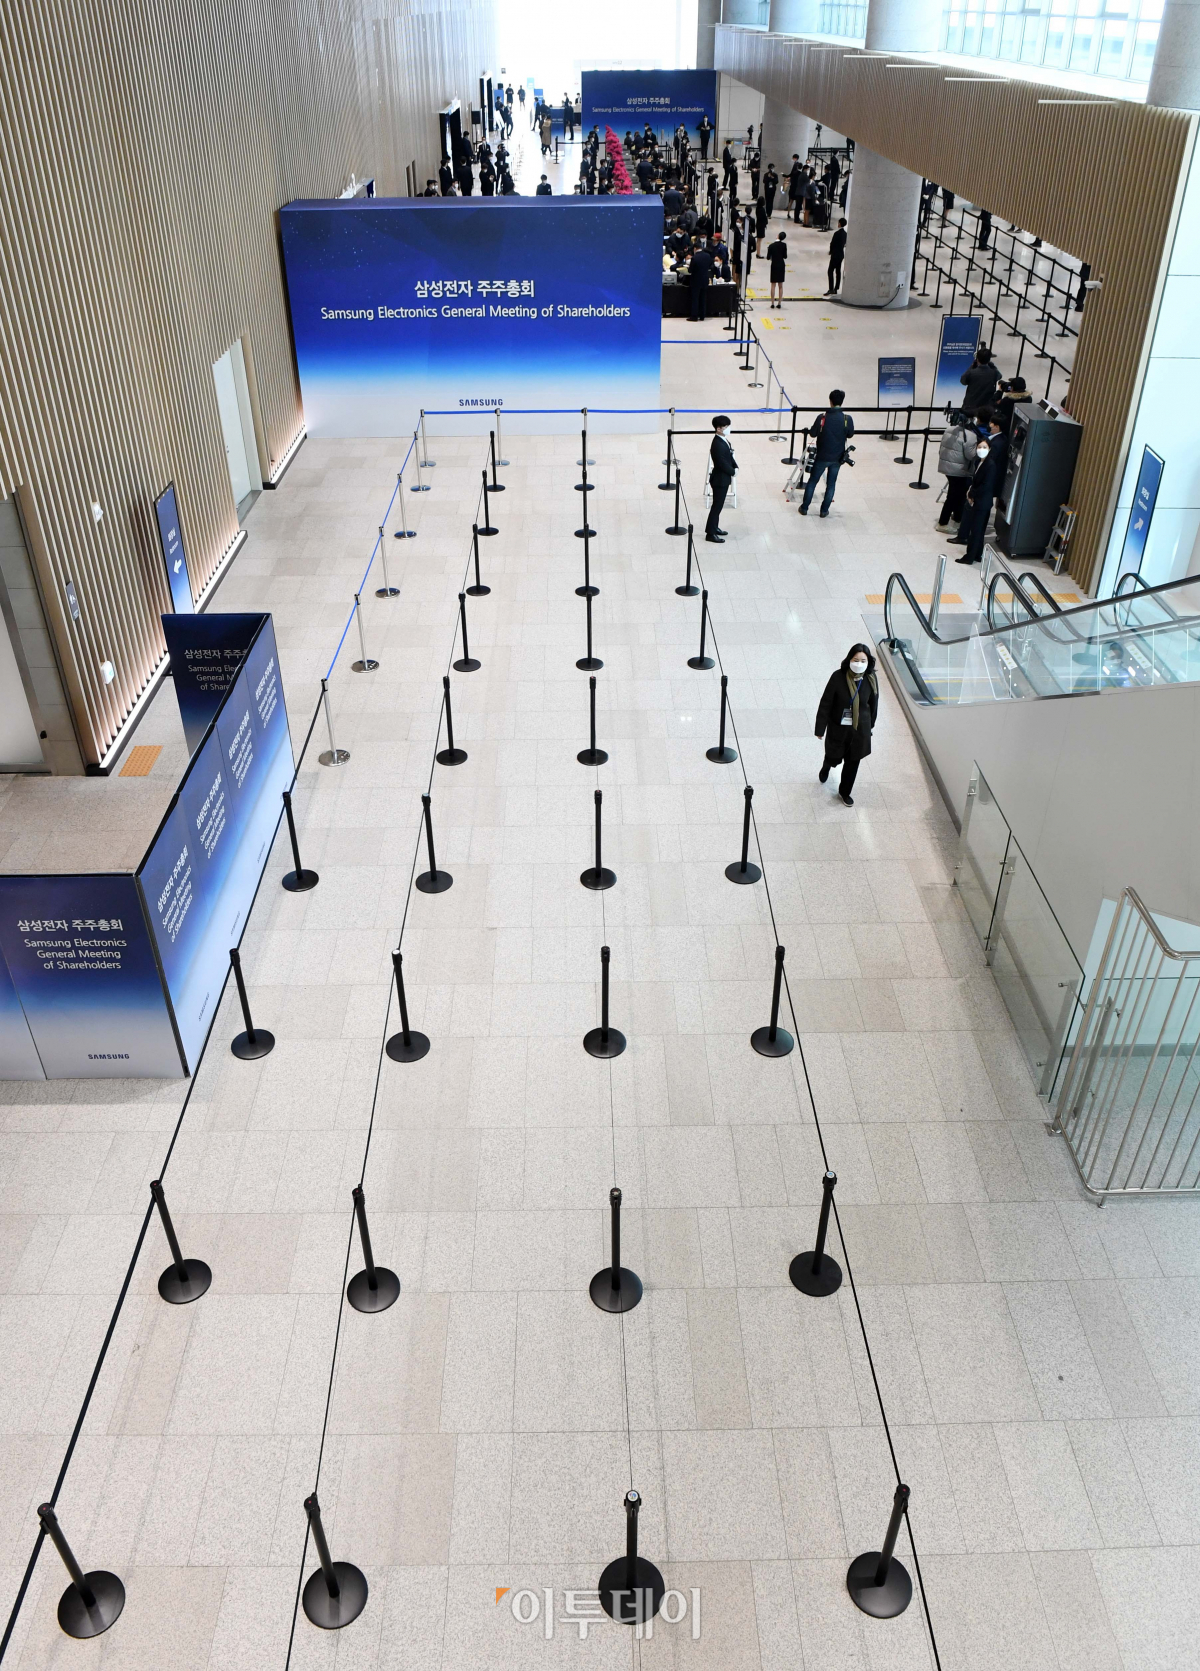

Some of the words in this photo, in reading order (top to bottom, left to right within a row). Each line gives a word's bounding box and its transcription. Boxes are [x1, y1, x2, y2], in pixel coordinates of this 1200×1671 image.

[414, 280, 473, 298] 삼성전자
[476, 280, 535, 298] 주주총회
[321, 306, 374, 321] Samsung
[378, 305, 438, 319] Electronics
[441, 305, 486, 318] General
[489, 305, 538, 319] Meeting
[541, 304, 554, 317] of
[557, 304, 630, 317] Shareholders
[458, 398, 504, 406] SAMSUNG
[184, 649, 221, 659] 삼성전자
[188, 664, 222, 672] Samsung
[197, 796, 210, 830] 삼성전자
[210, 771, 221, 801] 주주총회
[200, 817, 213, 844] Samsung
[212, 791, 224, 819] Electronics
[205, 825, 215, 850] General
[214, 805, 224, 829] Meeting
[211, 816, 226, 852] Shareholders
[158, 872, 174, 913] 삼성전자
[173, 844, 188, 879] 주주총회
[162, 896, 177, 928] Samsung
[176, 865, 191, 898] Electronics
[168, 904, 180, 933] General
[178, 881, 191, 908] Meeting
[175, 893, 193, 935] Shareholders
[17, 919, 69, 932] 삼성전자
[72, 919, 123, 931] 주주총회
[24, 939, 72, 948] Samsung
[74, 938, 127, 947] Electronics
[36, 950, 76, 959] General
[79, 950, 121, 960] Meeting
[43, 961, 54, 970] of
[57, 961, 122, 970] Shareholders
